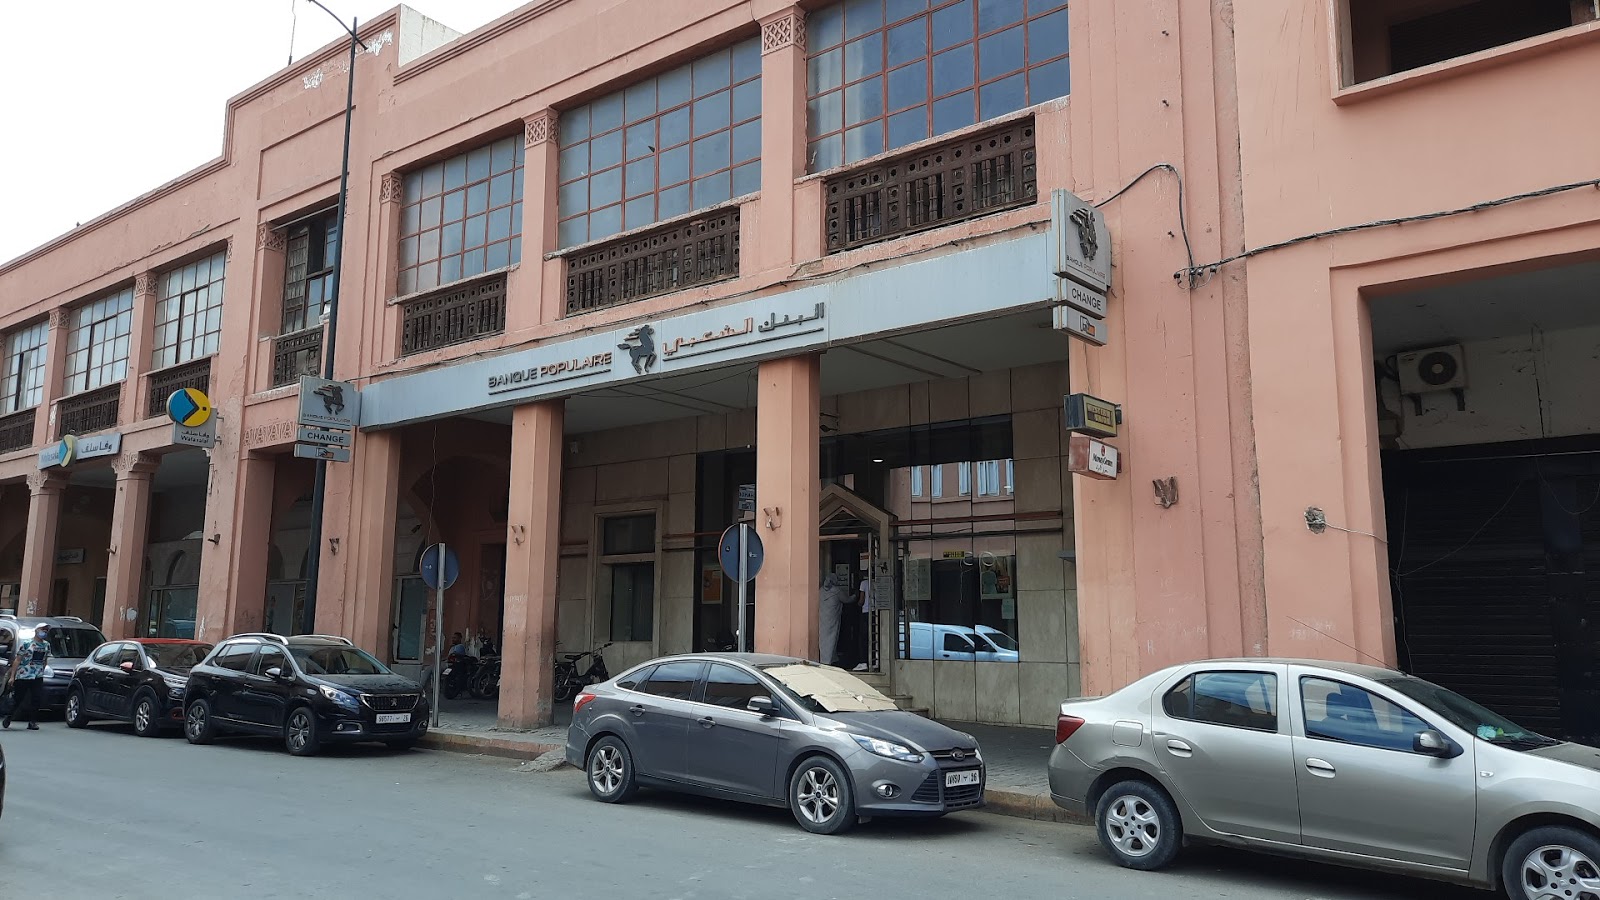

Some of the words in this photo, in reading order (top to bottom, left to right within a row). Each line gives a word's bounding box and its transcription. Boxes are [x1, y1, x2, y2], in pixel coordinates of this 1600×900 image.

[1071, 288, 1102, 311] CHANGE
[758, 302, 825, 333] البنك
[662, 317, 754, 355] الشعبي
[488, 367, 538, 388] BANQUE
[540, 352, 612, 378] POPULAIRE
[307, 432, 344, 443] CHANGE
